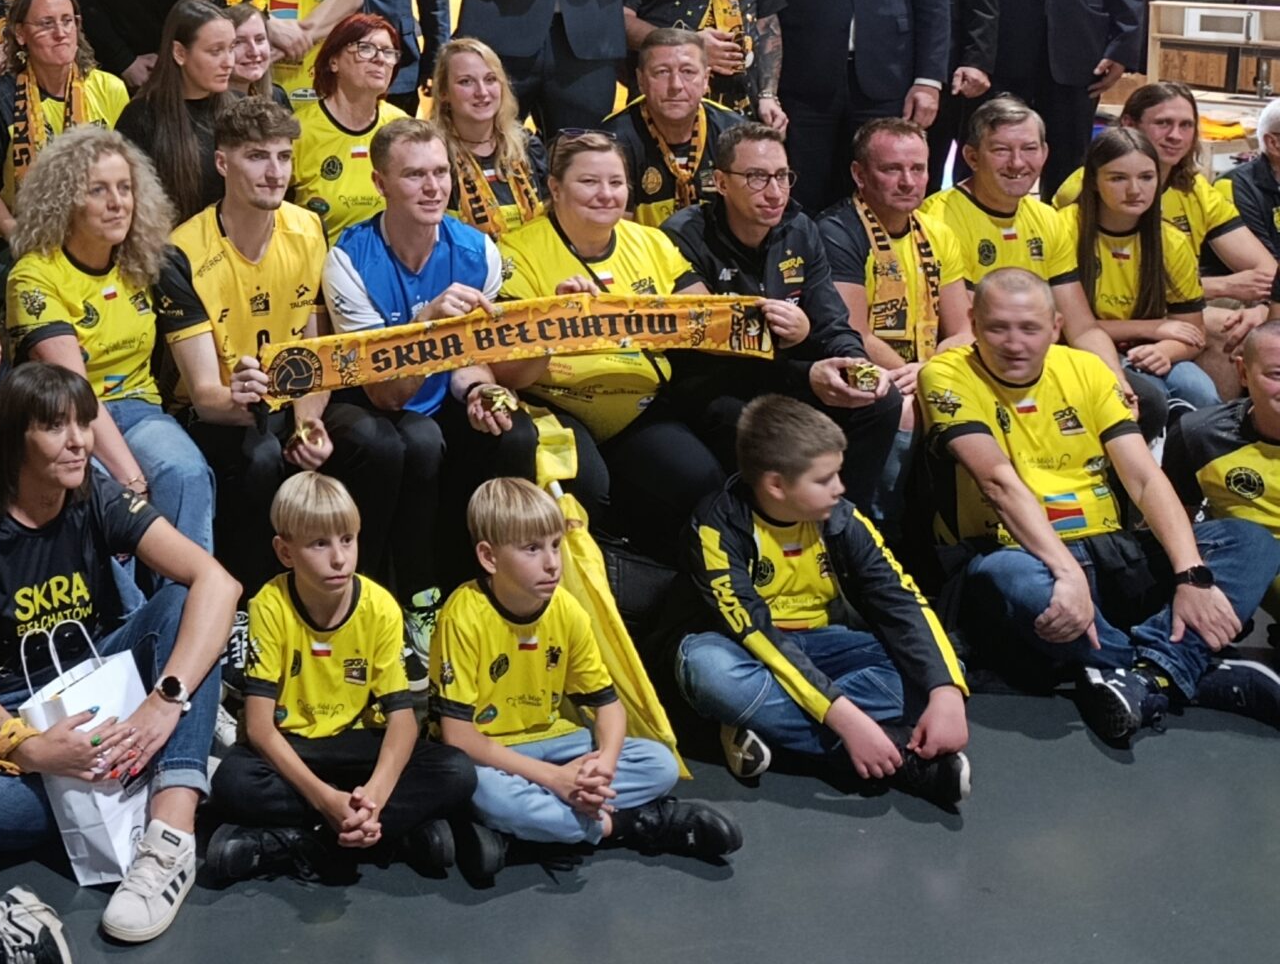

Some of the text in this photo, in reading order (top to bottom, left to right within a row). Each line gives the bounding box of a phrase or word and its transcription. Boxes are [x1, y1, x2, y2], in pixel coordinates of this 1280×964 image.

[778, 256, 805, 271] SKRA
[872, 297, 908, 315] SKRA
[371, 308, 679, 374] SKRA BEŁCHATÓW
[14, 572, 91, 621] SKRA
[16, 602, 93, 637] BEŁCHATÓW
